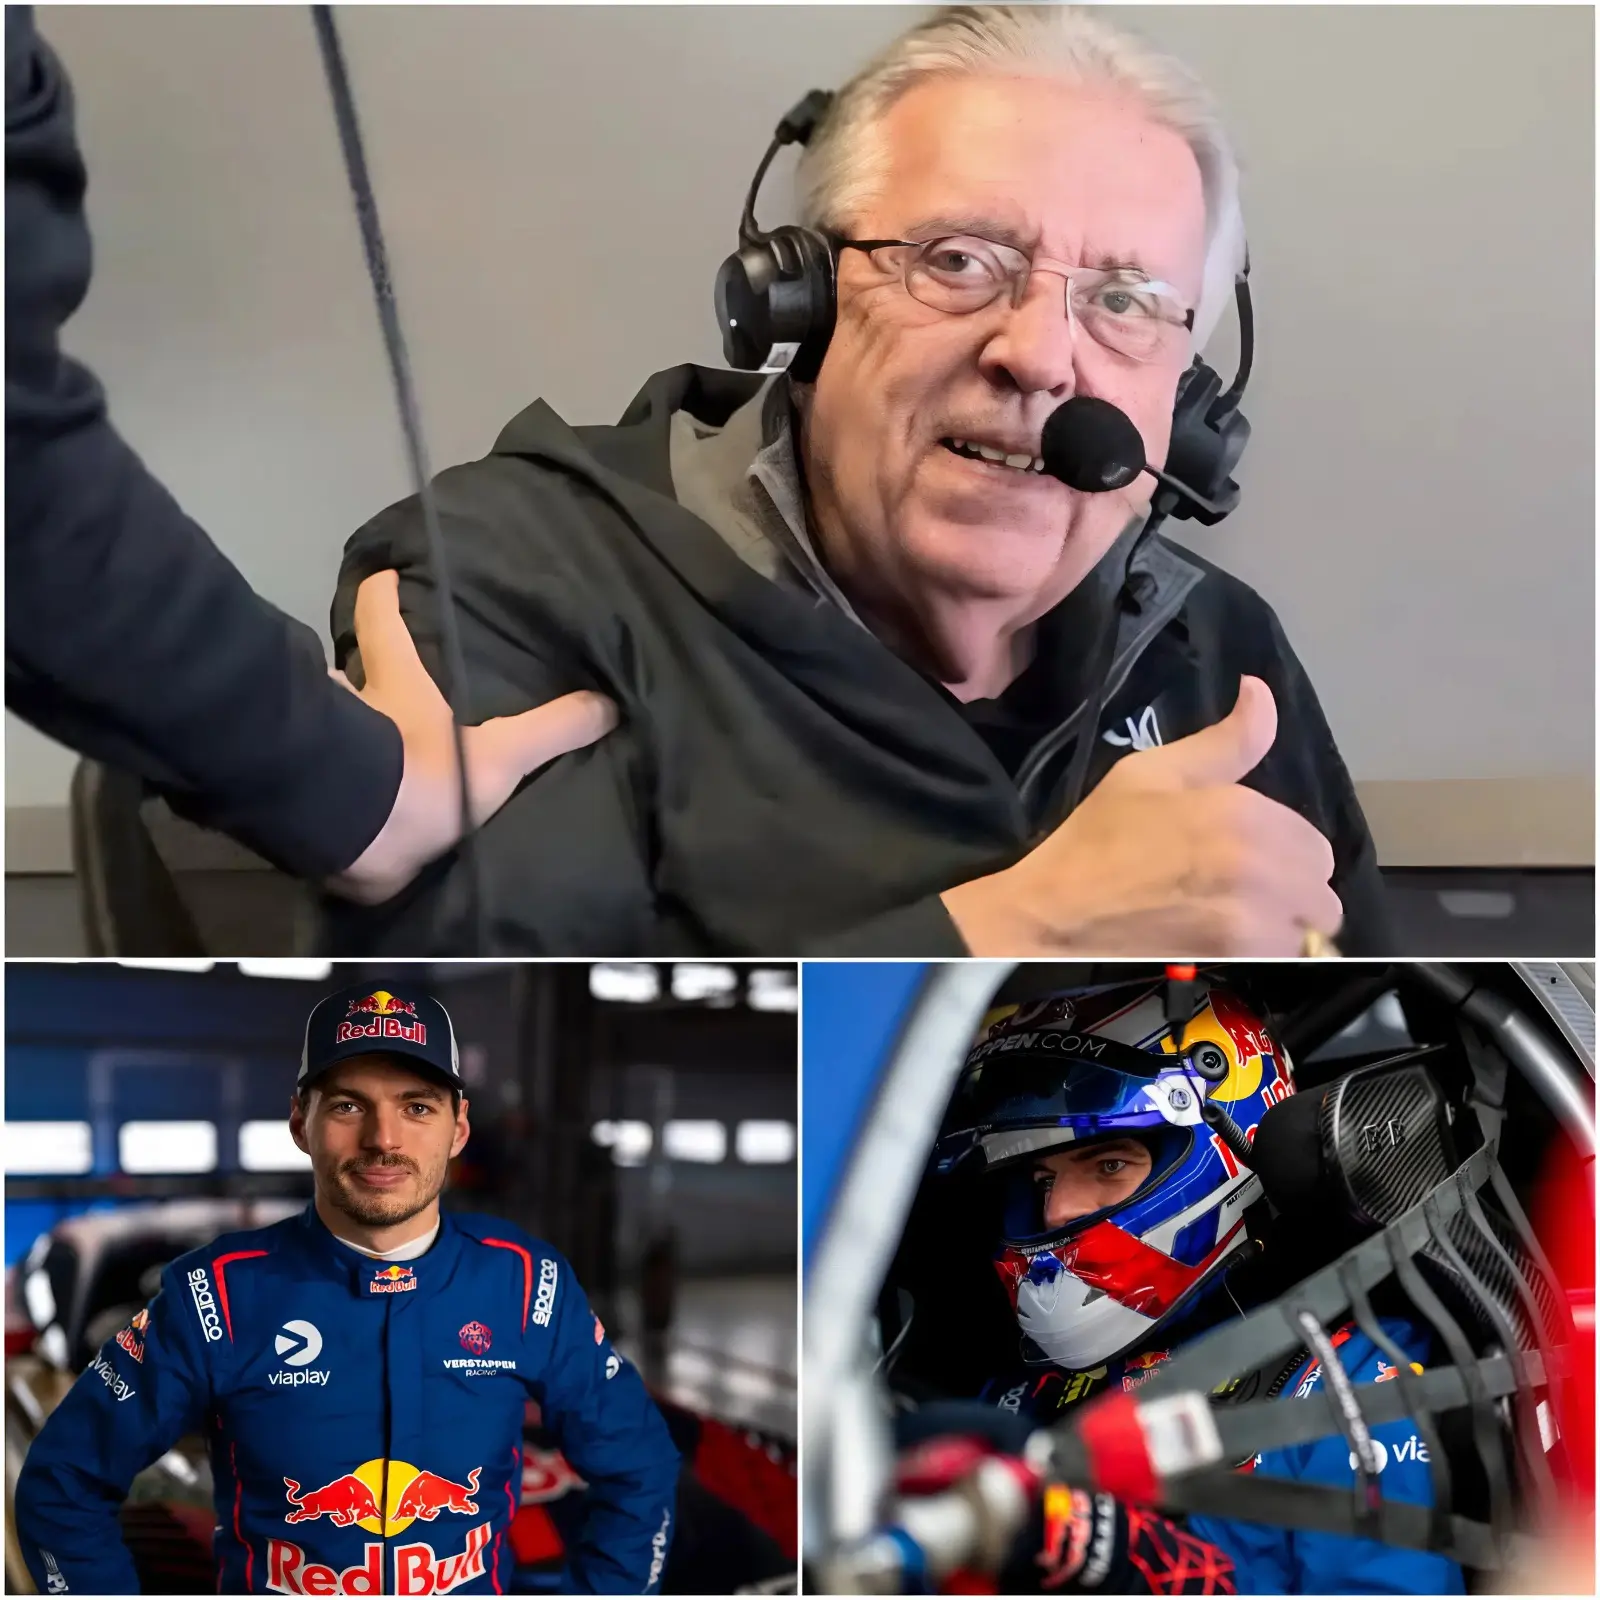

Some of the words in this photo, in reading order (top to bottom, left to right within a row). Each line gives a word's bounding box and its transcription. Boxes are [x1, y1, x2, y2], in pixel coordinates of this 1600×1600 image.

[336, 1016, 382, 1044] Red
[383, 1018, 427, 1045] Bull
[370, 1280, 394, 1293] Red
[394, 1277, 417, 1292] Bull
[532, 1258, 558, 1328] sparco
[187, 1268, 223, 1343] sparco
[94, 1355, 136, 1401] viaplay
[268, 1369, 331, 1387] viaplay
[443, 1359, 517, 1370] VERSTAPPEN
[266, 1538, 385, 1596] Red
[394, 1521, 492, 1596] Bull
